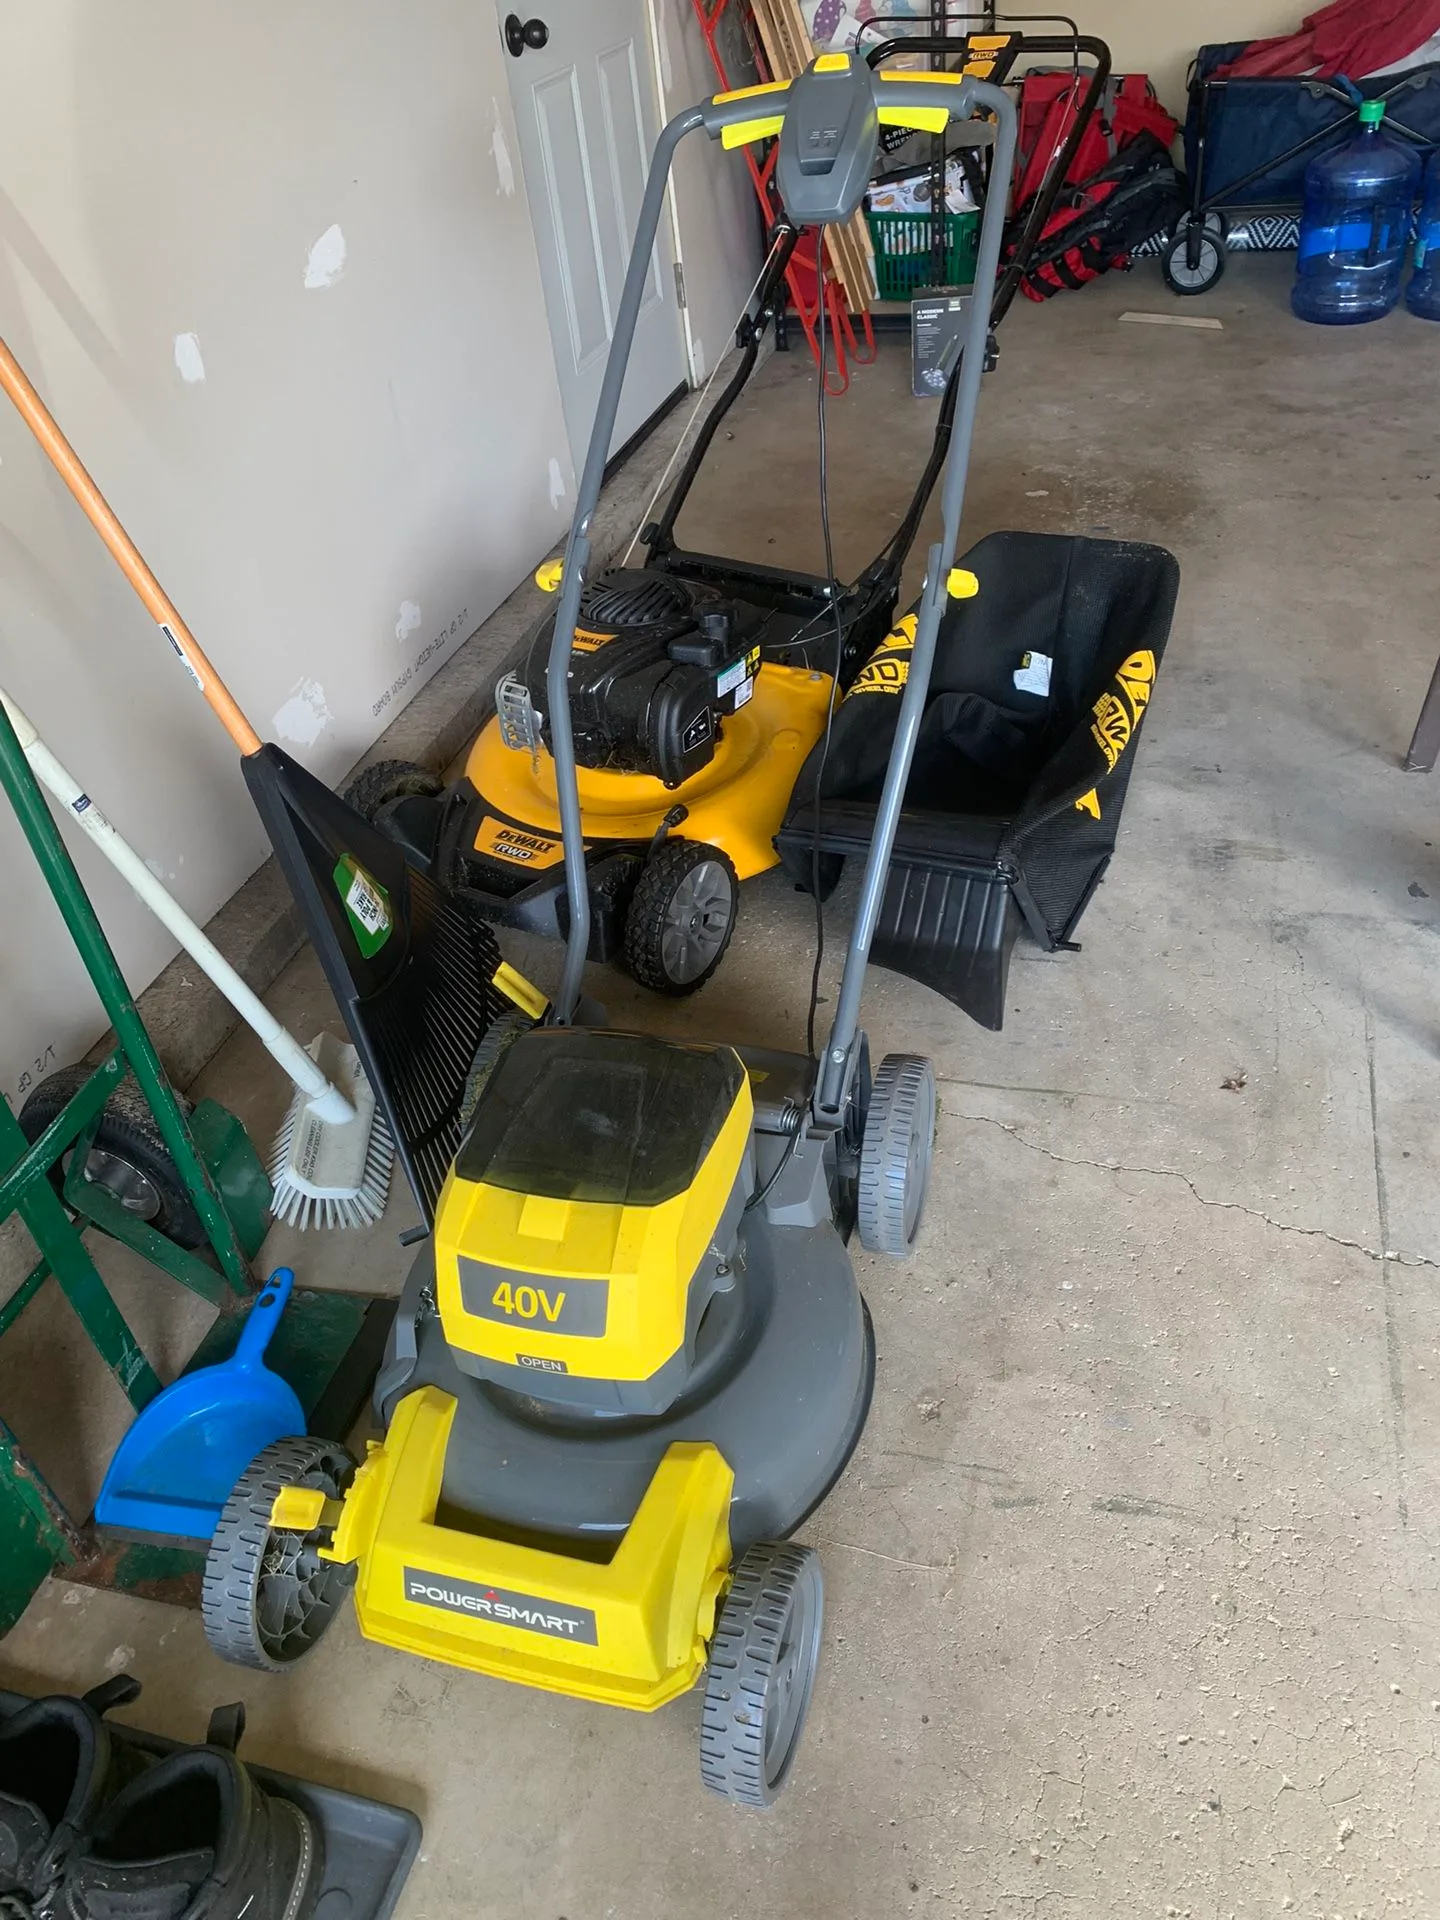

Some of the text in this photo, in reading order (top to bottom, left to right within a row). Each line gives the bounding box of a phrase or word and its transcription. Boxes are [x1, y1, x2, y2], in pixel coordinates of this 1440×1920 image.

[495, 842, 532, 860] RWD
[18, 1044, 56, 1093] 1/2 GP
[492, 1281, 567, 1322] 40V
[521, 1356, 562, 1371] OPEN
